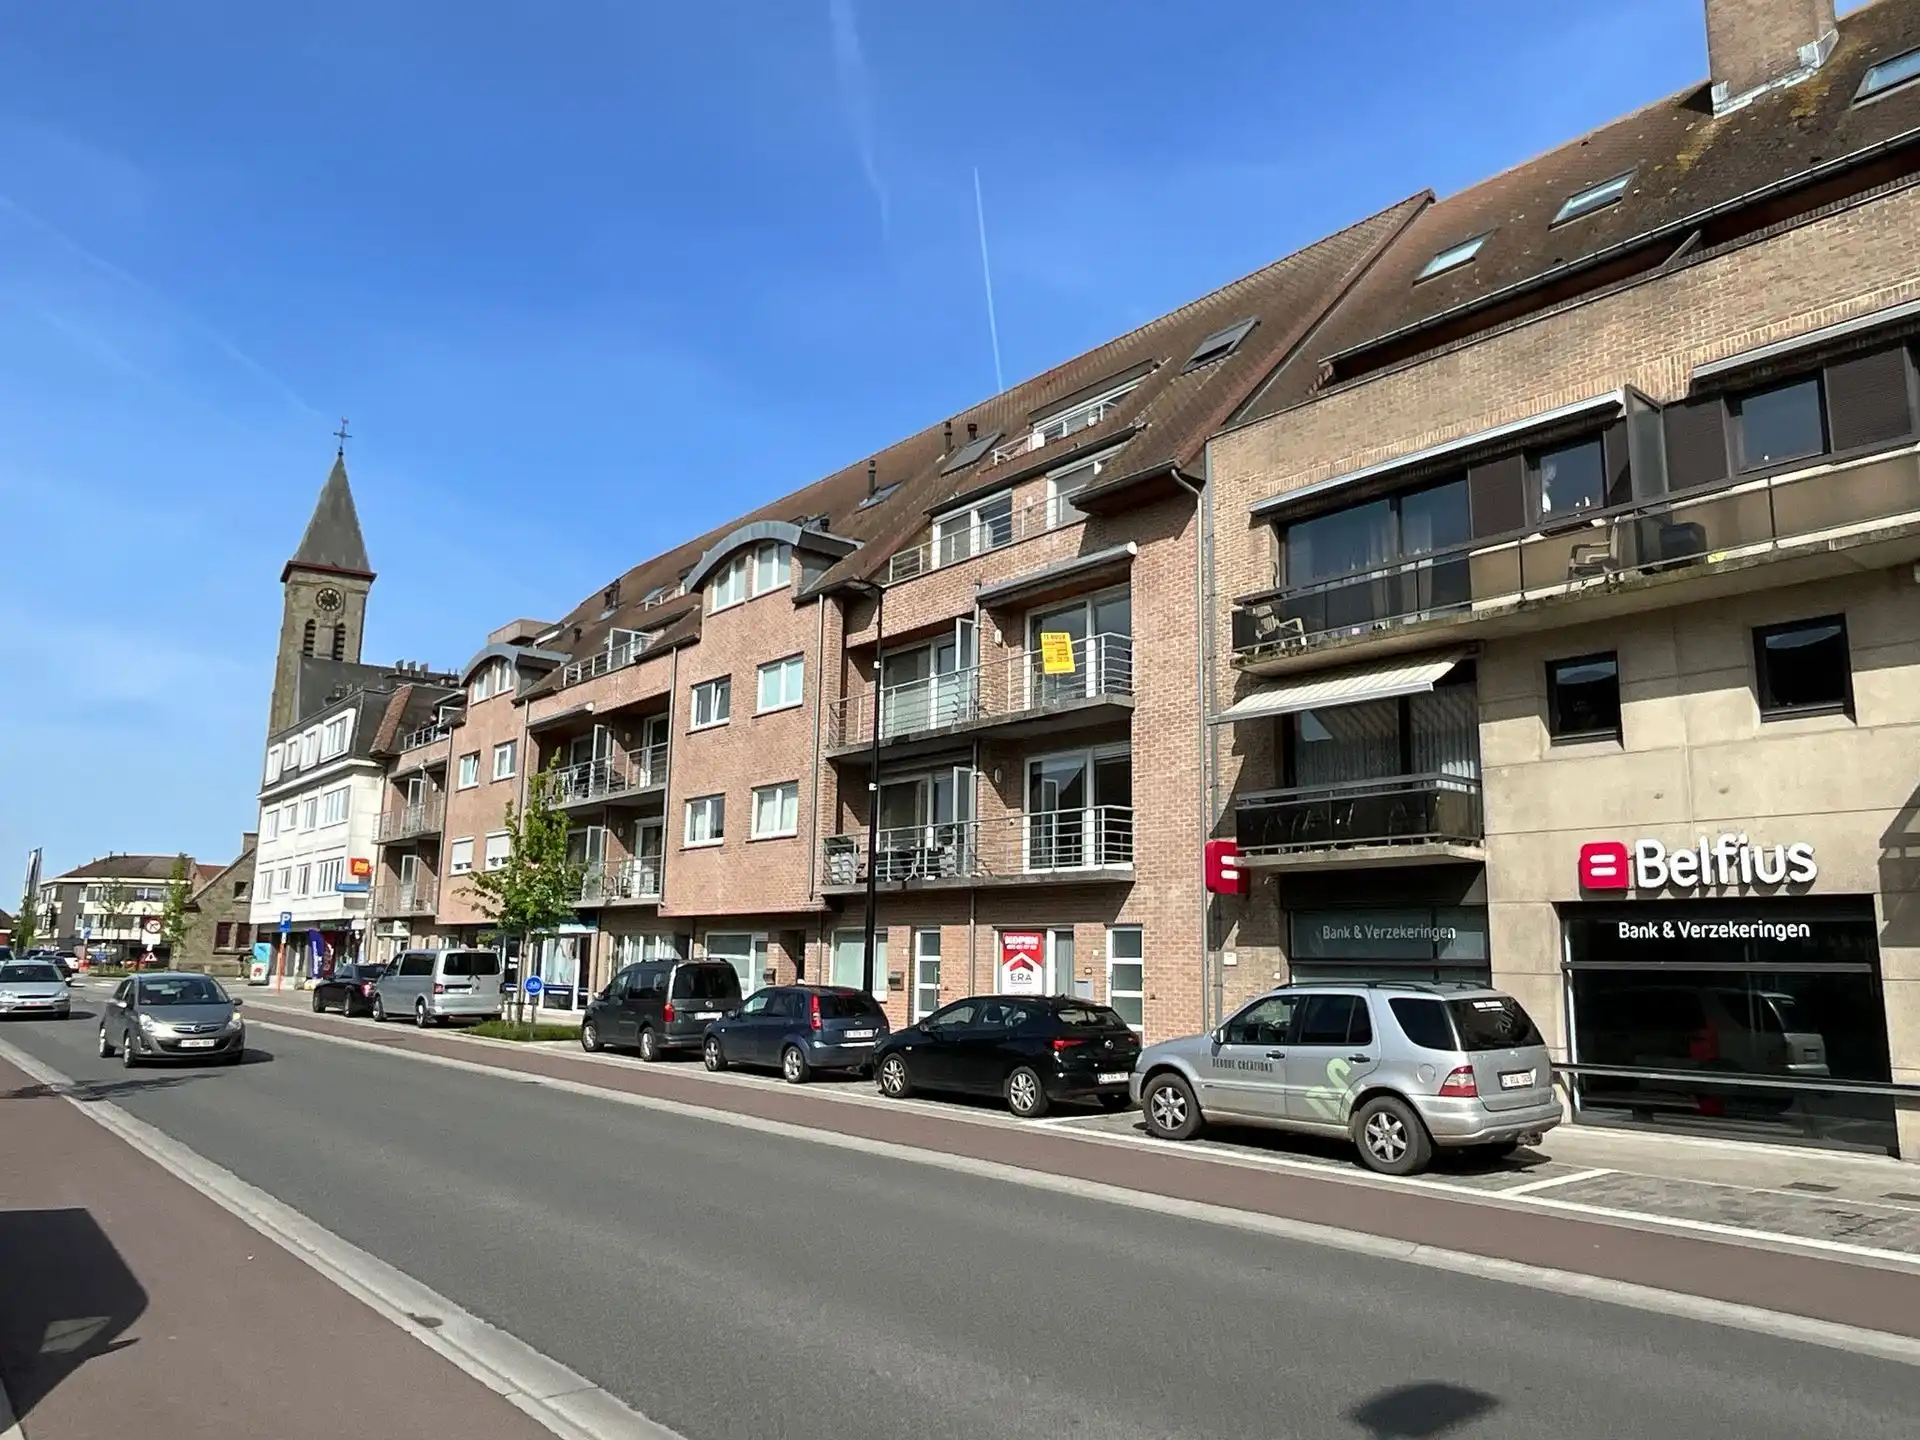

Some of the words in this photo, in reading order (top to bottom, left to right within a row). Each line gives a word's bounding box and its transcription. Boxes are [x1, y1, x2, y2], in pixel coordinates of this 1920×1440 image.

[1634, 832, 1818, 889] Belfius
[1322, 925, 1350, 940] Bank
[1353, 925, 1363, 940] &
[1364, 924, 1457, 941] Verzekeringen
[1618, 921, 1659, 939] Bank
[1662, 921, 1676, 939] &
[1678, 920, 1811, 941] Verzekeringen
[1010, 973, 1033, 981] ERA
